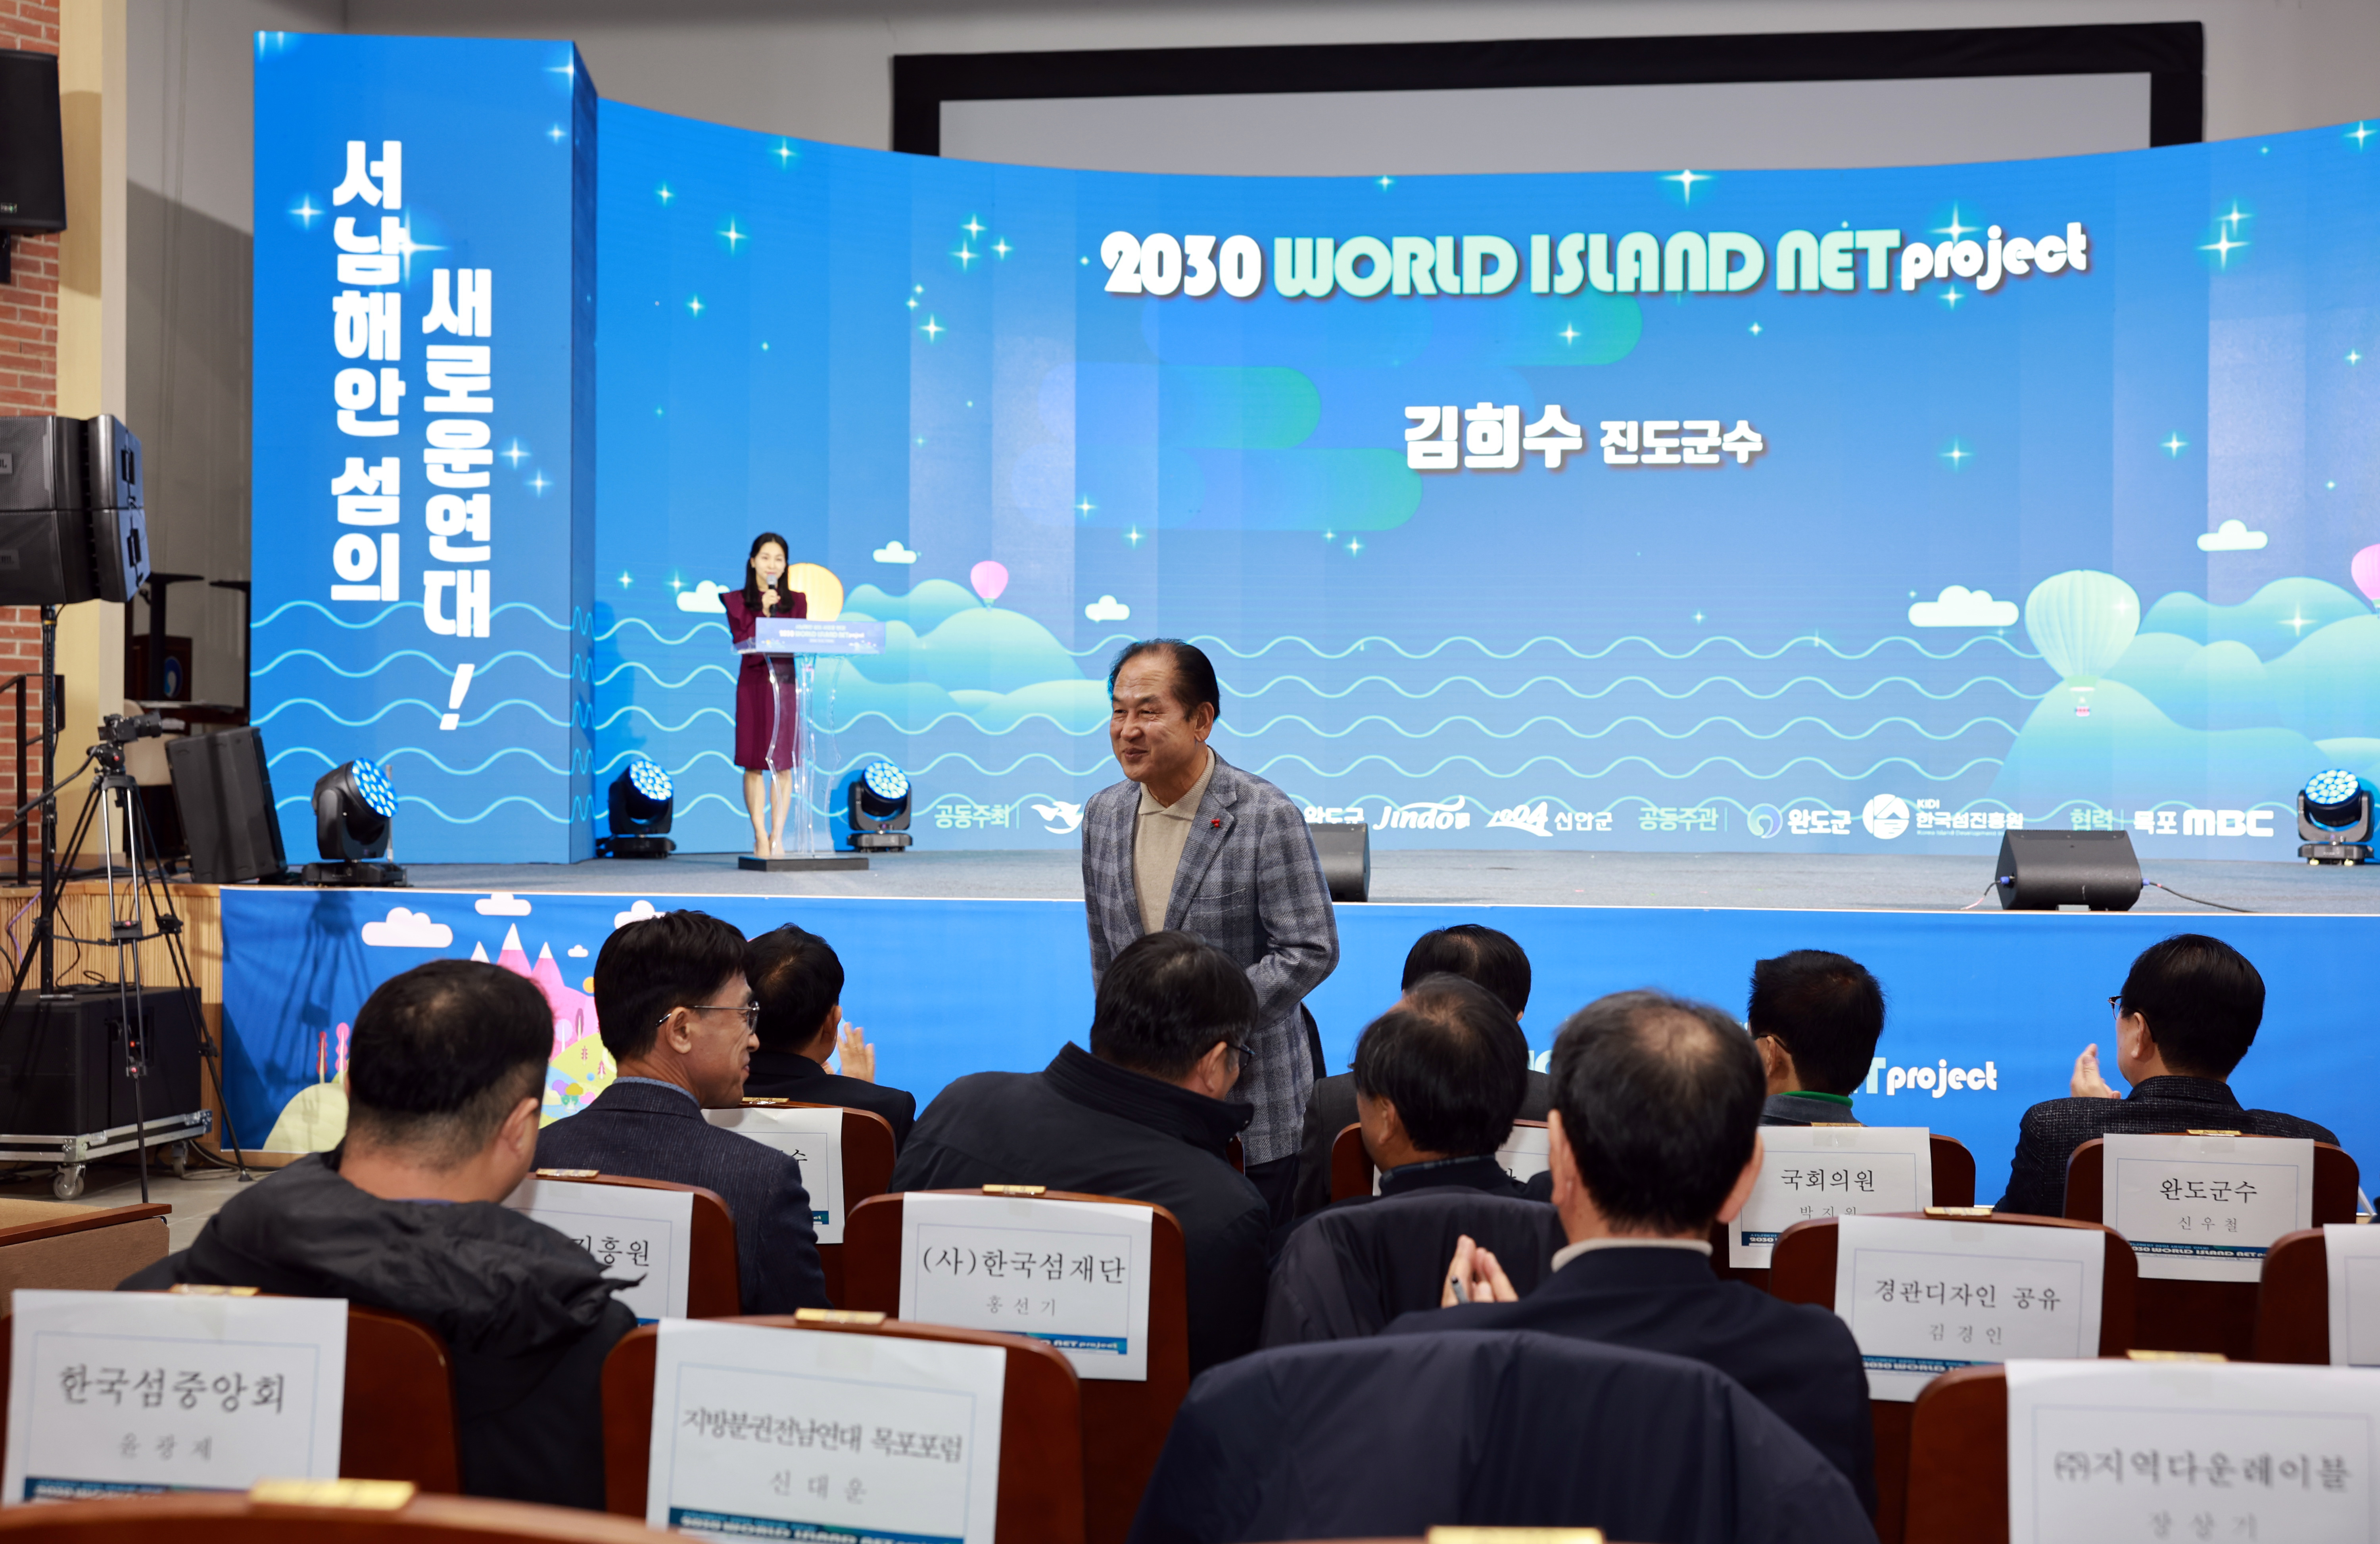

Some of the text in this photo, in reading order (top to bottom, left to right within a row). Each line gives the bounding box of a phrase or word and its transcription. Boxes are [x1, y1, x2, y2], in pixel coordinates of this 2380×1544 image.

[1100, 231, 1261, 297] 2030
[1274, 236, 1516, 296] WORLD
[1530, 232, 1764, 294] ISLAND
[330, 140, 405, 603] 서남해안 섬의
[1404, 402, 1764, 469] 김희수 진도군수
[934, 804, 1010, 829] 공동주최
[1916, 799, 1940, 809] KIDI
[1554, 812, 1613, 831] 신안군
[1638, 806, 1719, 832] 공동주관
[1788, 809, 1852, 835] 완도군
[1916, 812, 2023, 829] 한국섬진흥원
[2070, 808, 2114, 831] 협력
[1886, 1058, 1998, 1099] project
[1780, 1168, 1875, 1193] 국회의원
[2159, 1177, 2258, 1204] 완도군수
[923, 1246, 1127, 1285] (사)한국섬재단
[1874, 1279, 2062, 1312] 경관디자인 공유
[60, 1363, 286, 1415] 한국섬중앙회
[681, 1406, 964, 1464] 지방분권전남연대 목포포럼
